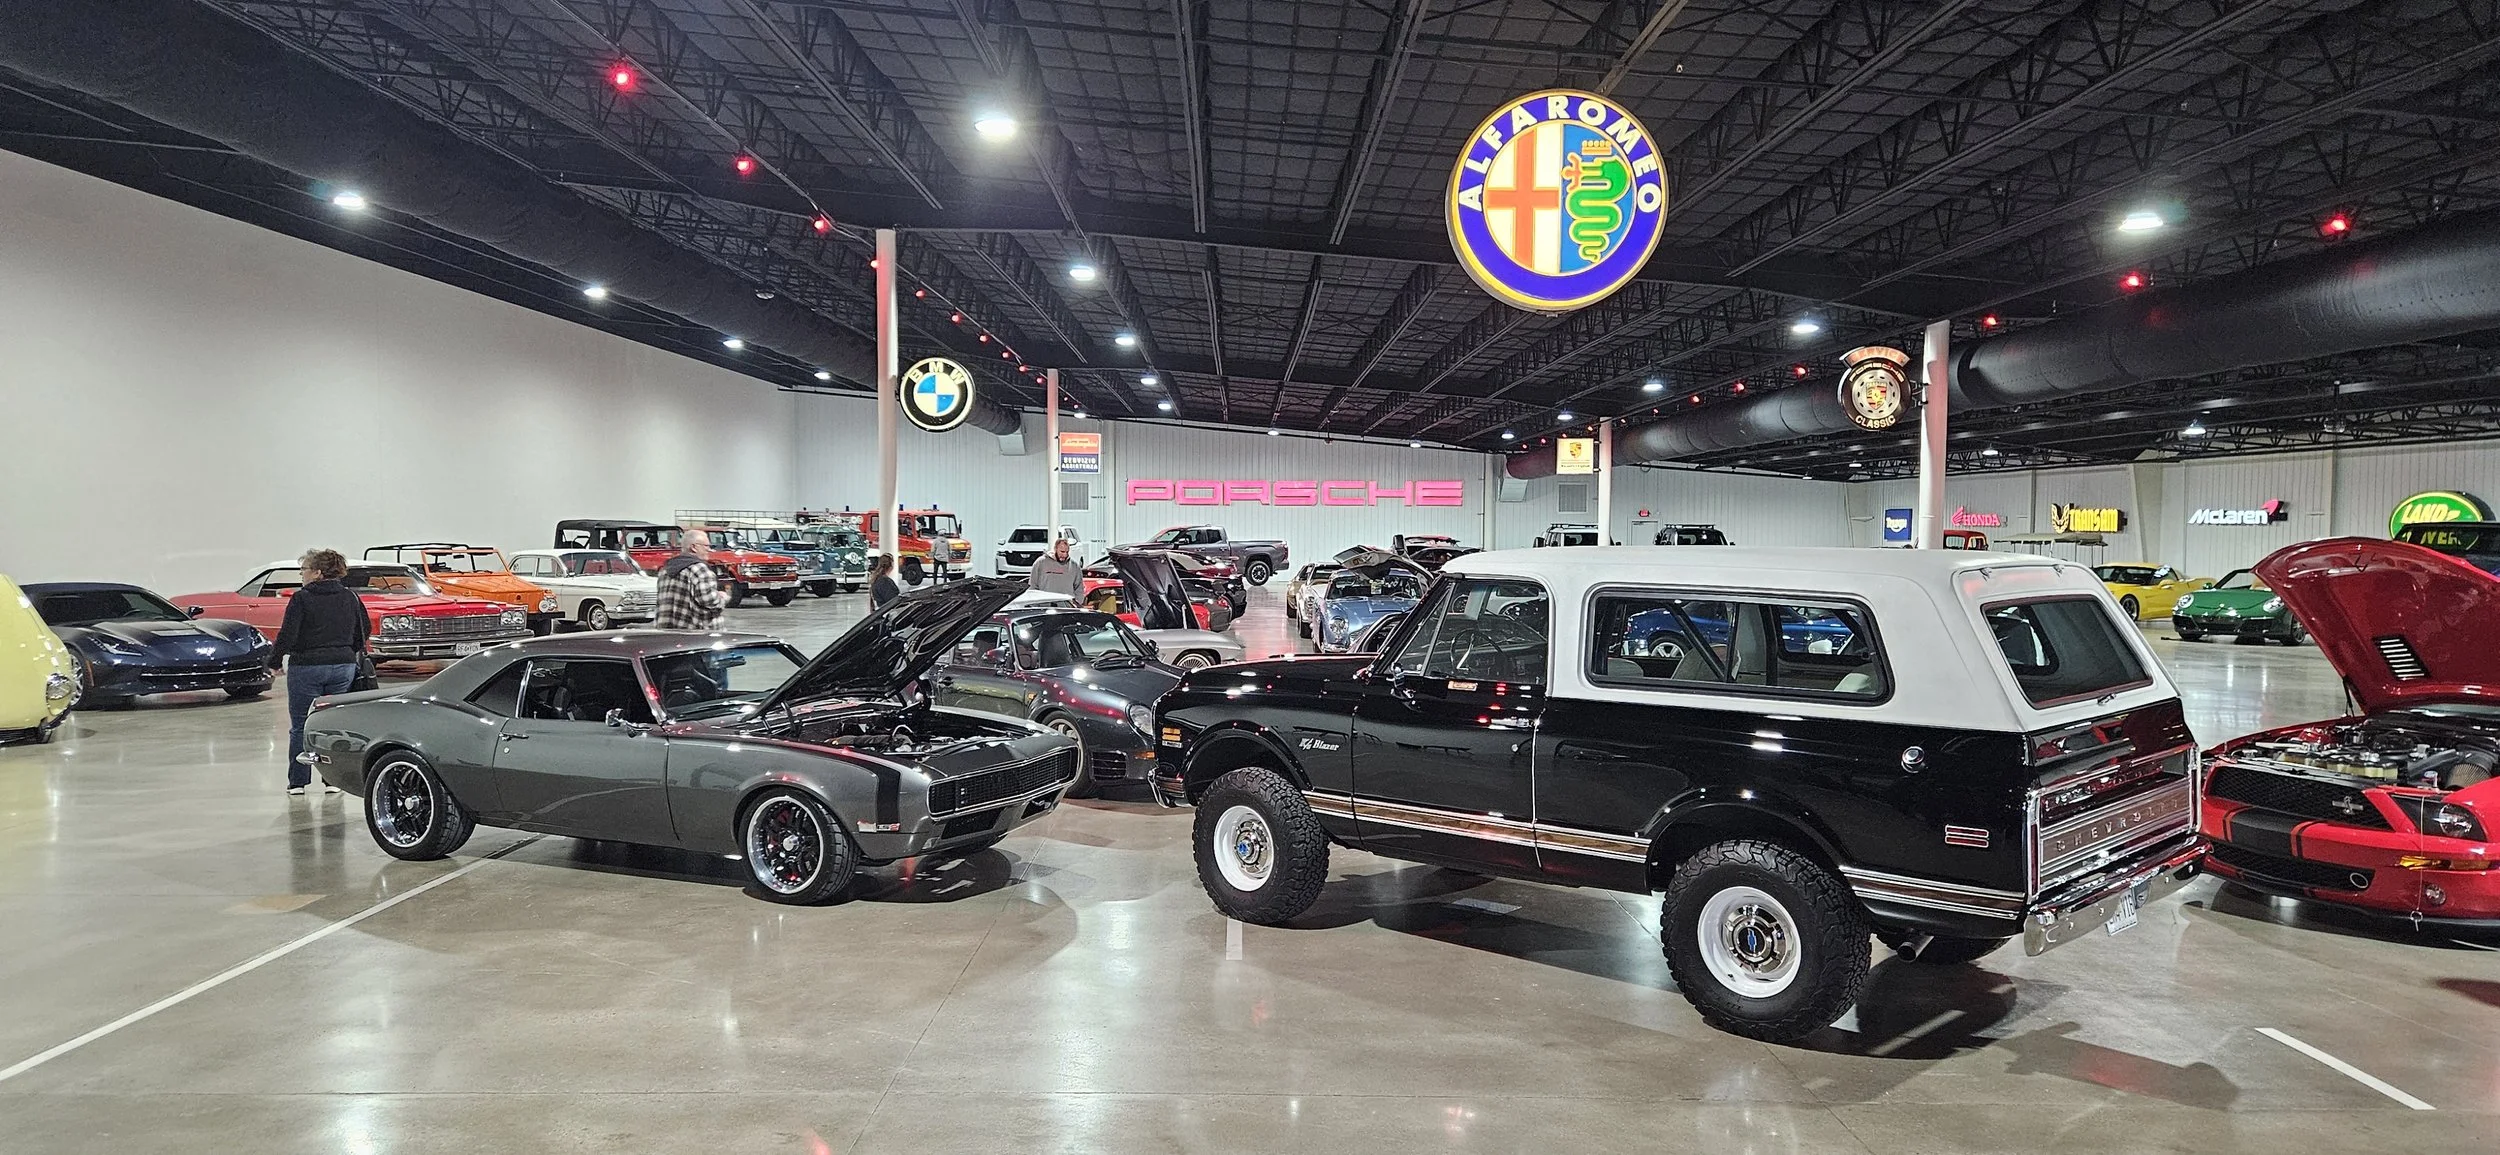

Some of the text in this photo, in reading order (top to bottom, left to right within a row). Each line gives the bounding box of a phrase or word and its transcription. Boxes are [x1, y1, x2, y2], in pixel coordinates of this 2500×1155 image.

[908, 361, 967, 386] BMW
[1854, 415, 1896, 429] CLASSIC
[1127, 480, 1464, 506] PORSCHE
[1962, 513, 2001, 526] HONDA
[2187, 508, 2269, 525] McLaren
[2400, 503, 2449, 523] LAND
[1312, 739, 1339, 751] Blazer
[2055, 799, 2179, 852] CHEVROLET
